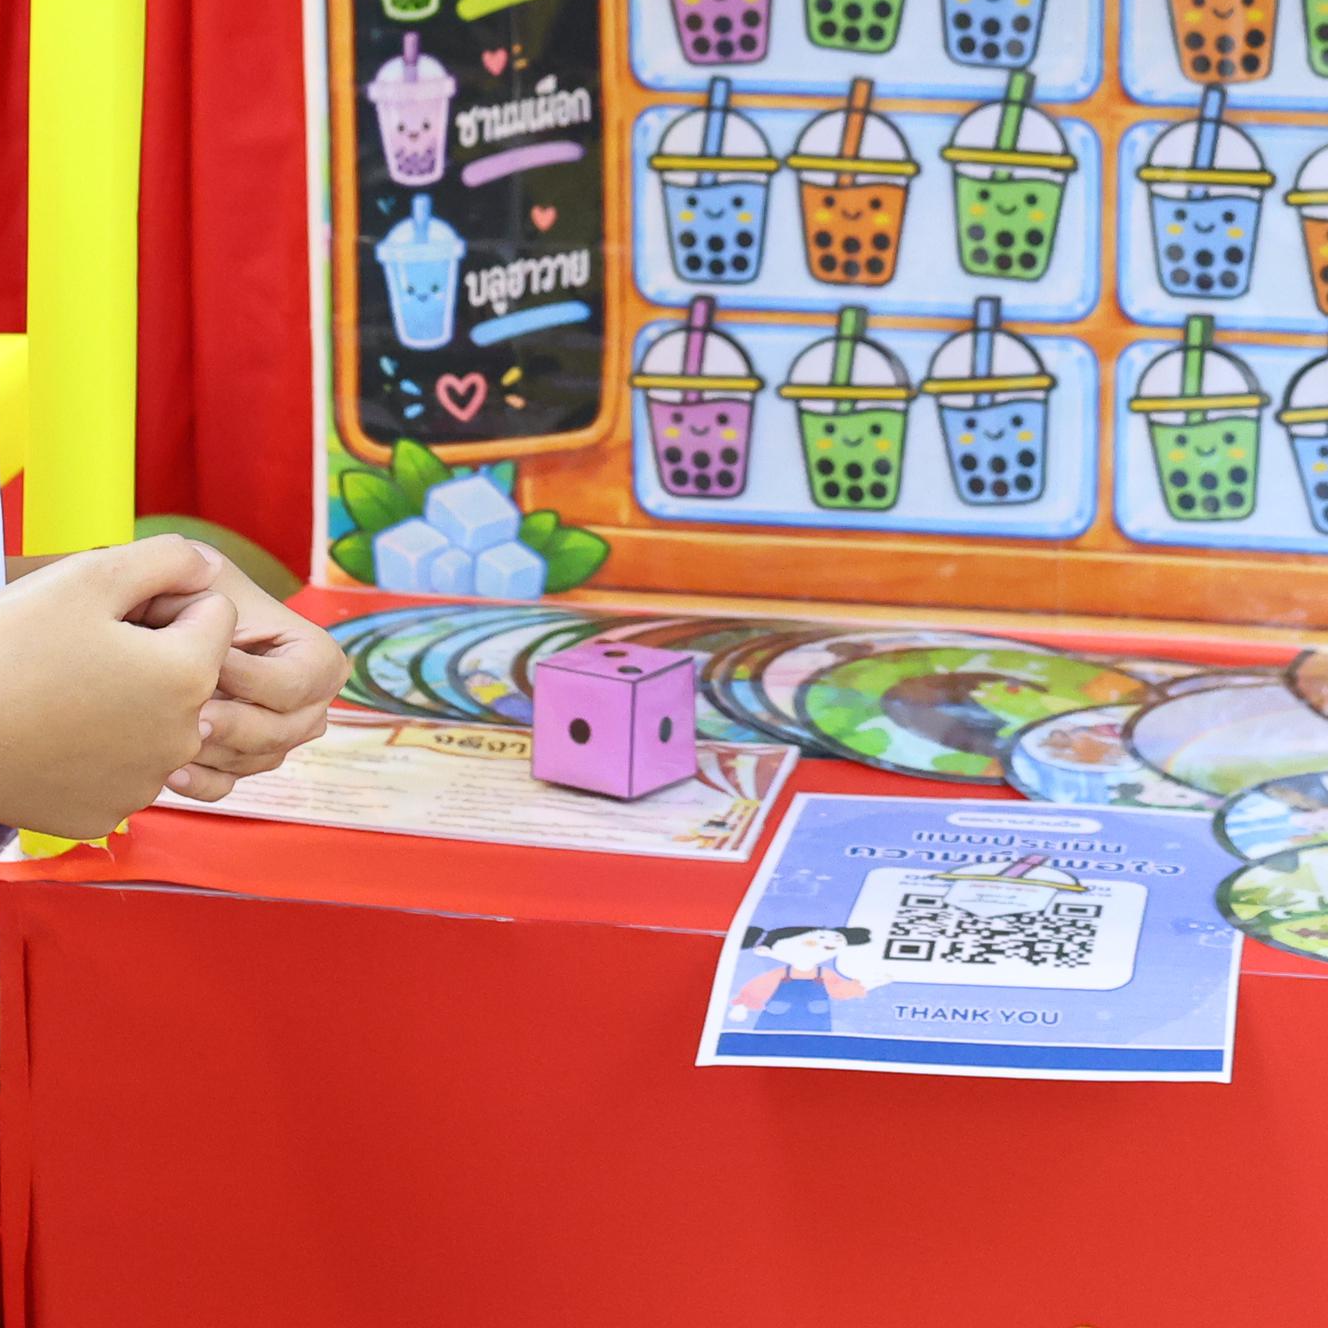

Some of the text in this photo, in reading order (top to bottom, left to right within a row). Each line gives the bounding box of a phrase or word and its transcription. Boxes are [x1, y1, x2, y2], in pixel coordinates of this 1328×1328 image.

[455, 74, 591, 148] ชานมเผือก
[464, 249, 591, 317] บลูฮาวาย
[913, 829, 1125, 854] แบบประเมิน
[845, 844, 1183, 876] ความพึพอใจ
[895, 1004, 1060, 1026] THANK YOU
